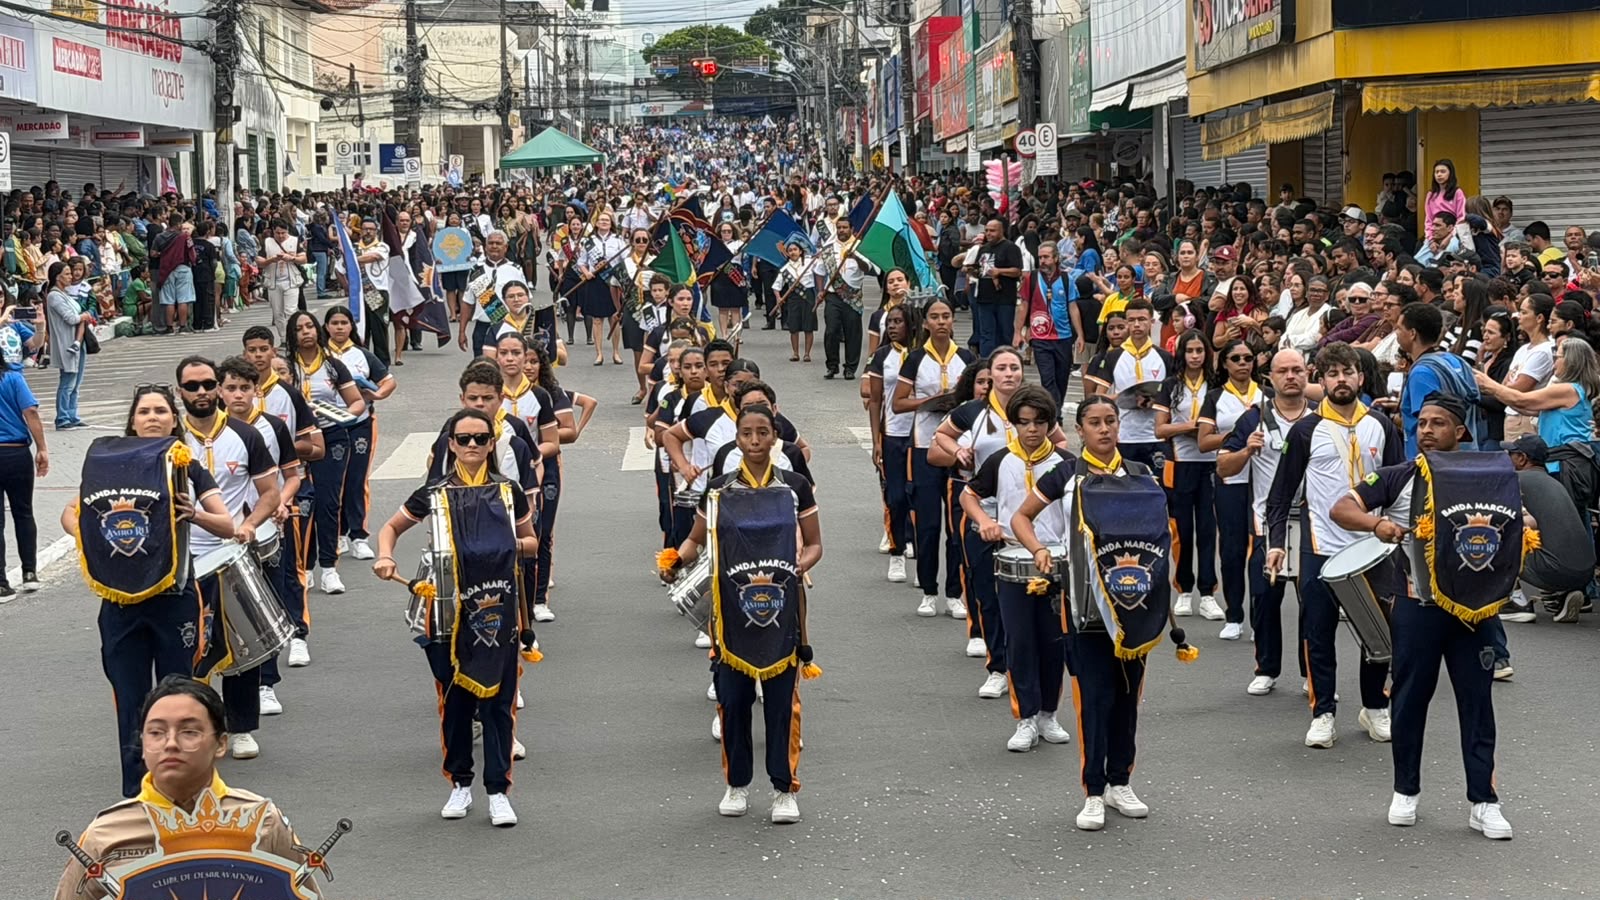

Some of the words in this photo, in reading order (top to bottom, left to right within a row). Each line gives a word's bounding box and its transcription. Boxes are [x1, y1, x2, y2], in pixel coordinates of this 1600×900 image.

[1019, 134, 1036, 147] 40
[1043, 130, 1049, 142] E
[83, 489, 118, 505] BANDA
[120, 488, 160, 501] MARCIAL
[1441, 502, 1473, 517] BANDA
[1475, 502, 1517, 519] MARCIAL
[1097, 541, 1122, 556] ANDA
[1124, 540, 1165, 558] MARCIAL
[152, 876, 179, 889] CLUBE
[180, 873, 192, 882] DE
